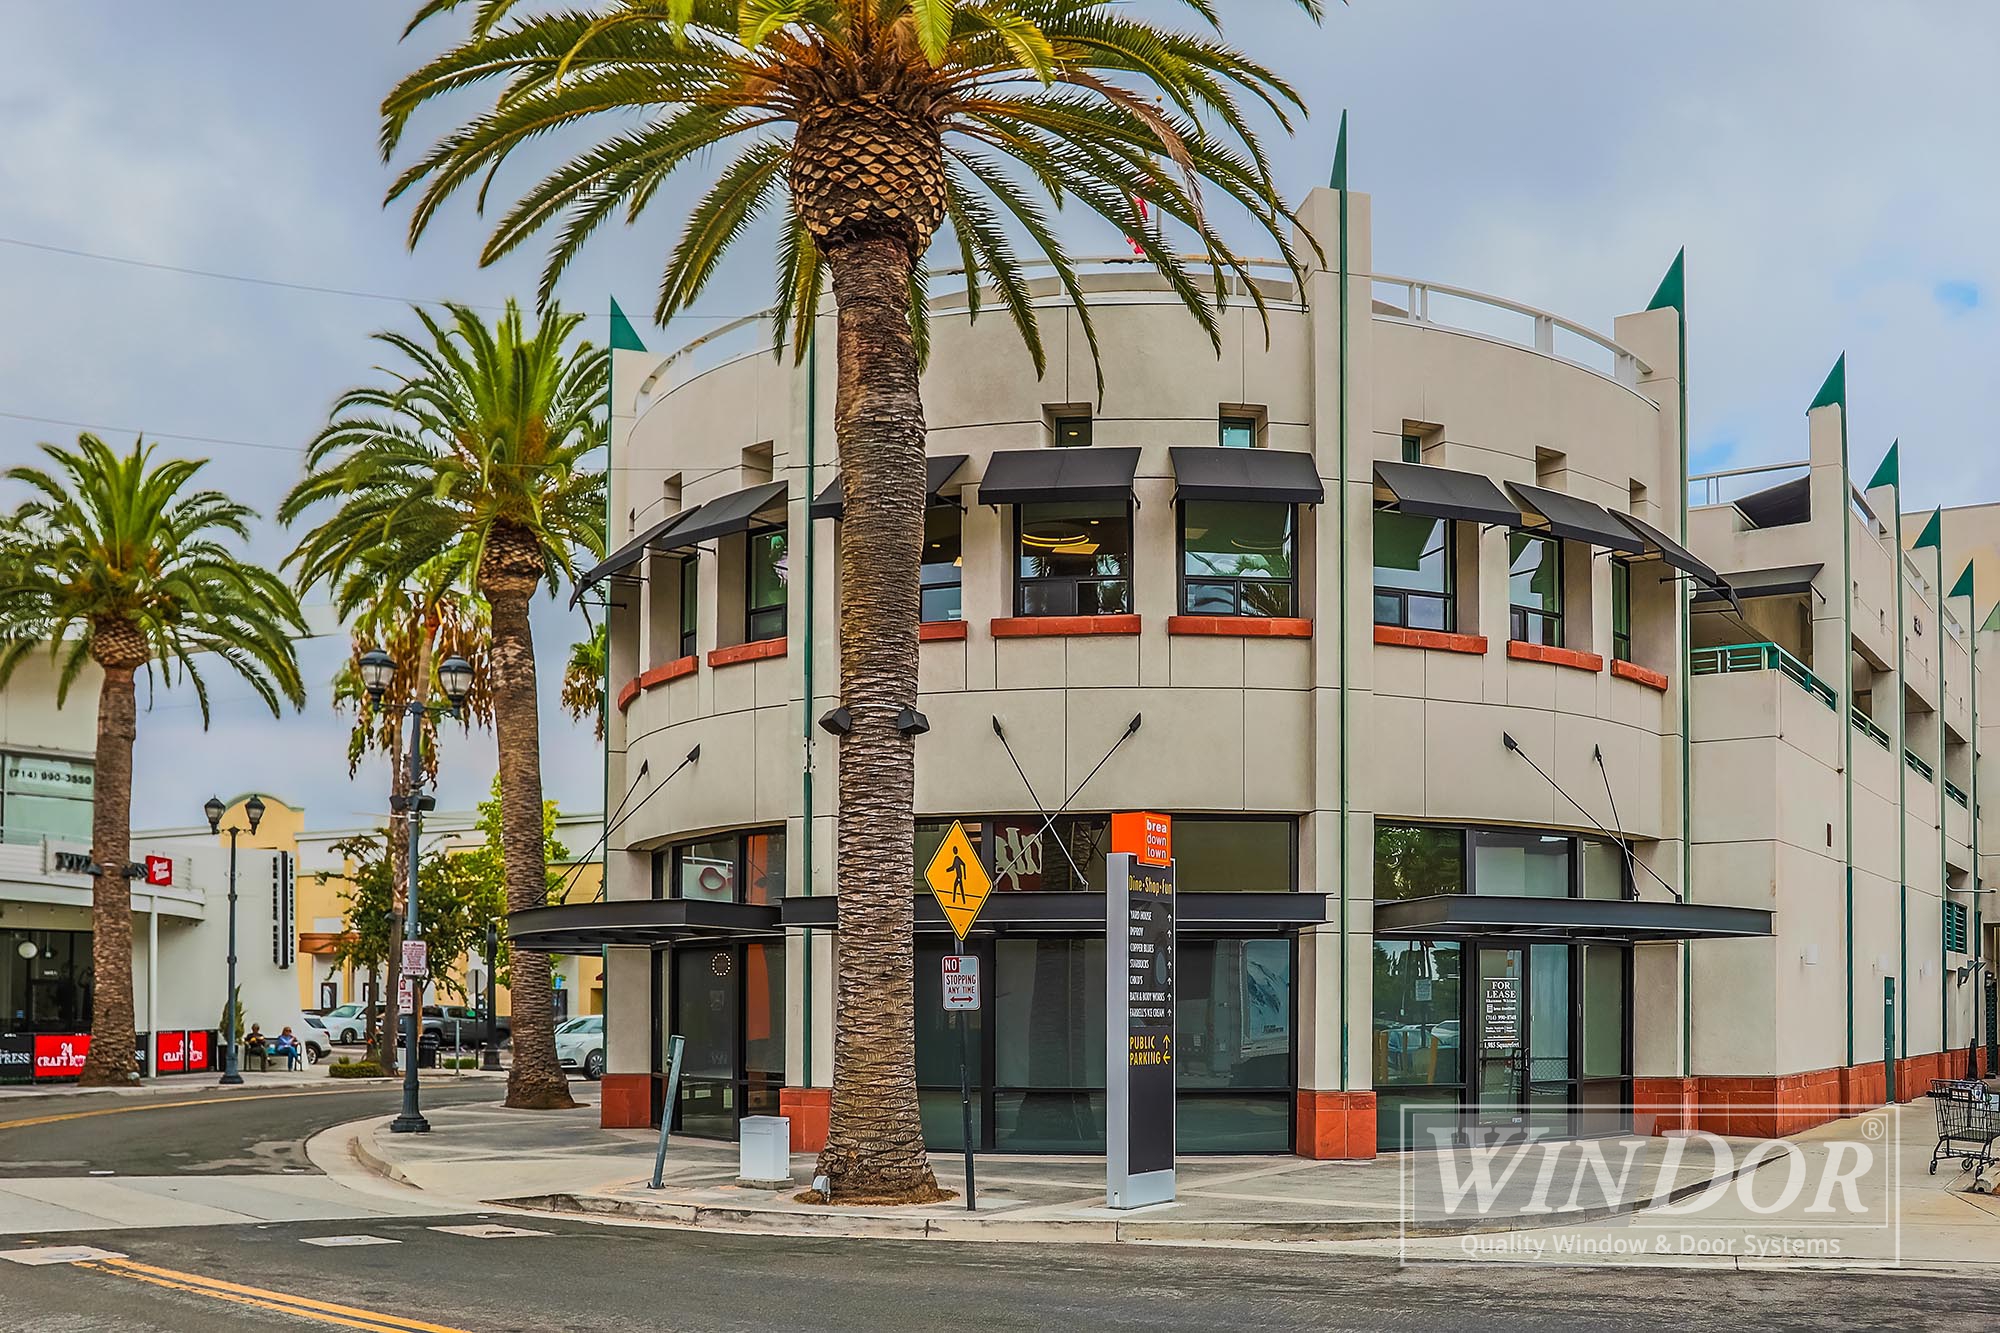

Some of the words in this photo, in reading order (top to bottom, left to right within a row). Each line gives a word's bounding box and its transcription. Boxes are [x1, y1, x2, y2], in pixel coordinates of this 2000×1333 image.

[1146, 819, 1167, 834] brea
[1146, 833, 1167, 847] down
[1147, 846, 1167, 859] town
[945, 959, 957, 971] NO
[946, 974, 976, 986] STOPPING
[1492, 981, 1511, 990] FOR
[948, 986, 960, 994] ANY
[962, 986, 975, 994] TIME
[1486, 990, 1517, 999] LEASE
[1130, 1036, 1155, 1050] PUBLIC
[37, 1055, 68, 1067] CRAFT
[1130, 1051, 1161, 1066] PARKING
